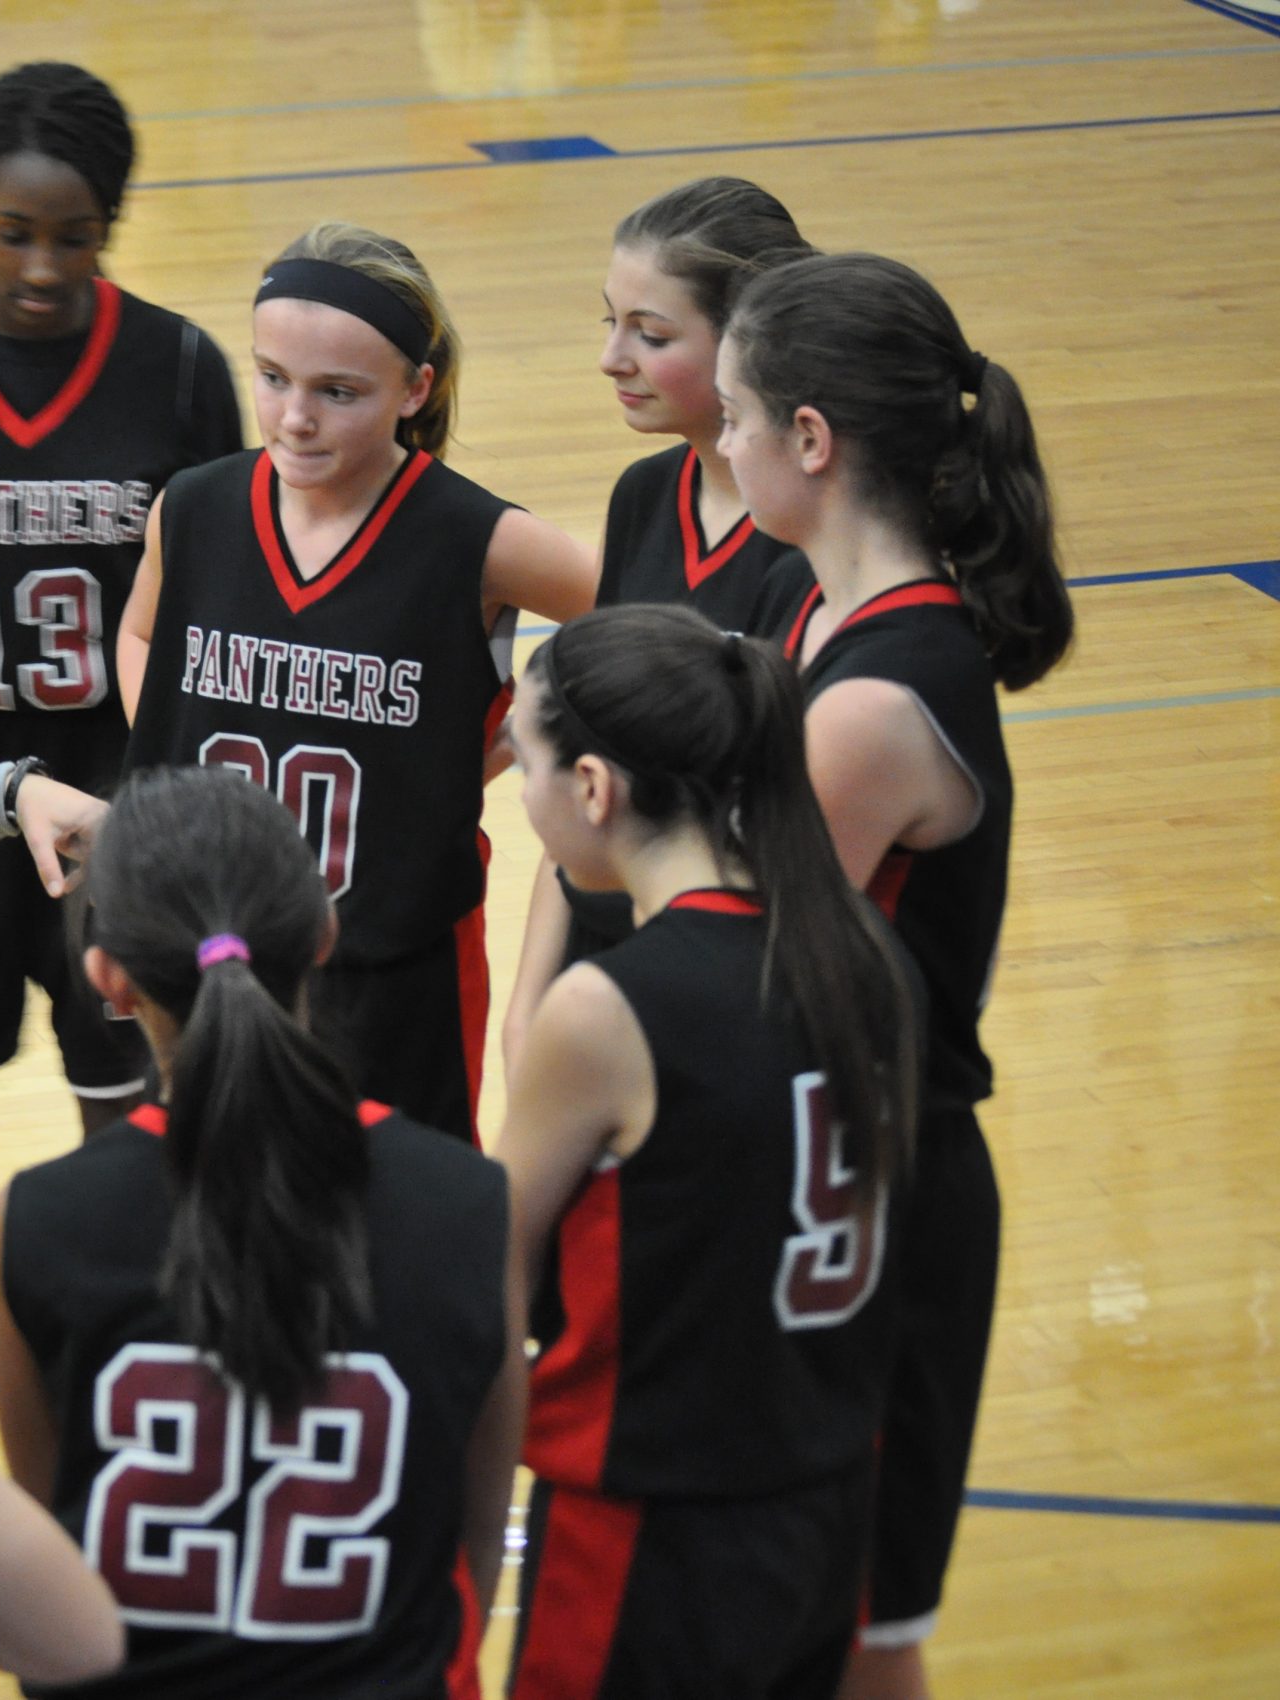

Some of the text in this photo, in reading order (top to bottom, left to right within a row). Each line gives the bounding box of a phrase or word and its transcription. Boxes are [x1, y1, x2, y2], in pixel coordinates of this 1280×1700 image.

[181, 625, 422, 727] PANTHERS
[199, 732, 362, 902] 0
[83, 1342, 409, 1641] 22
